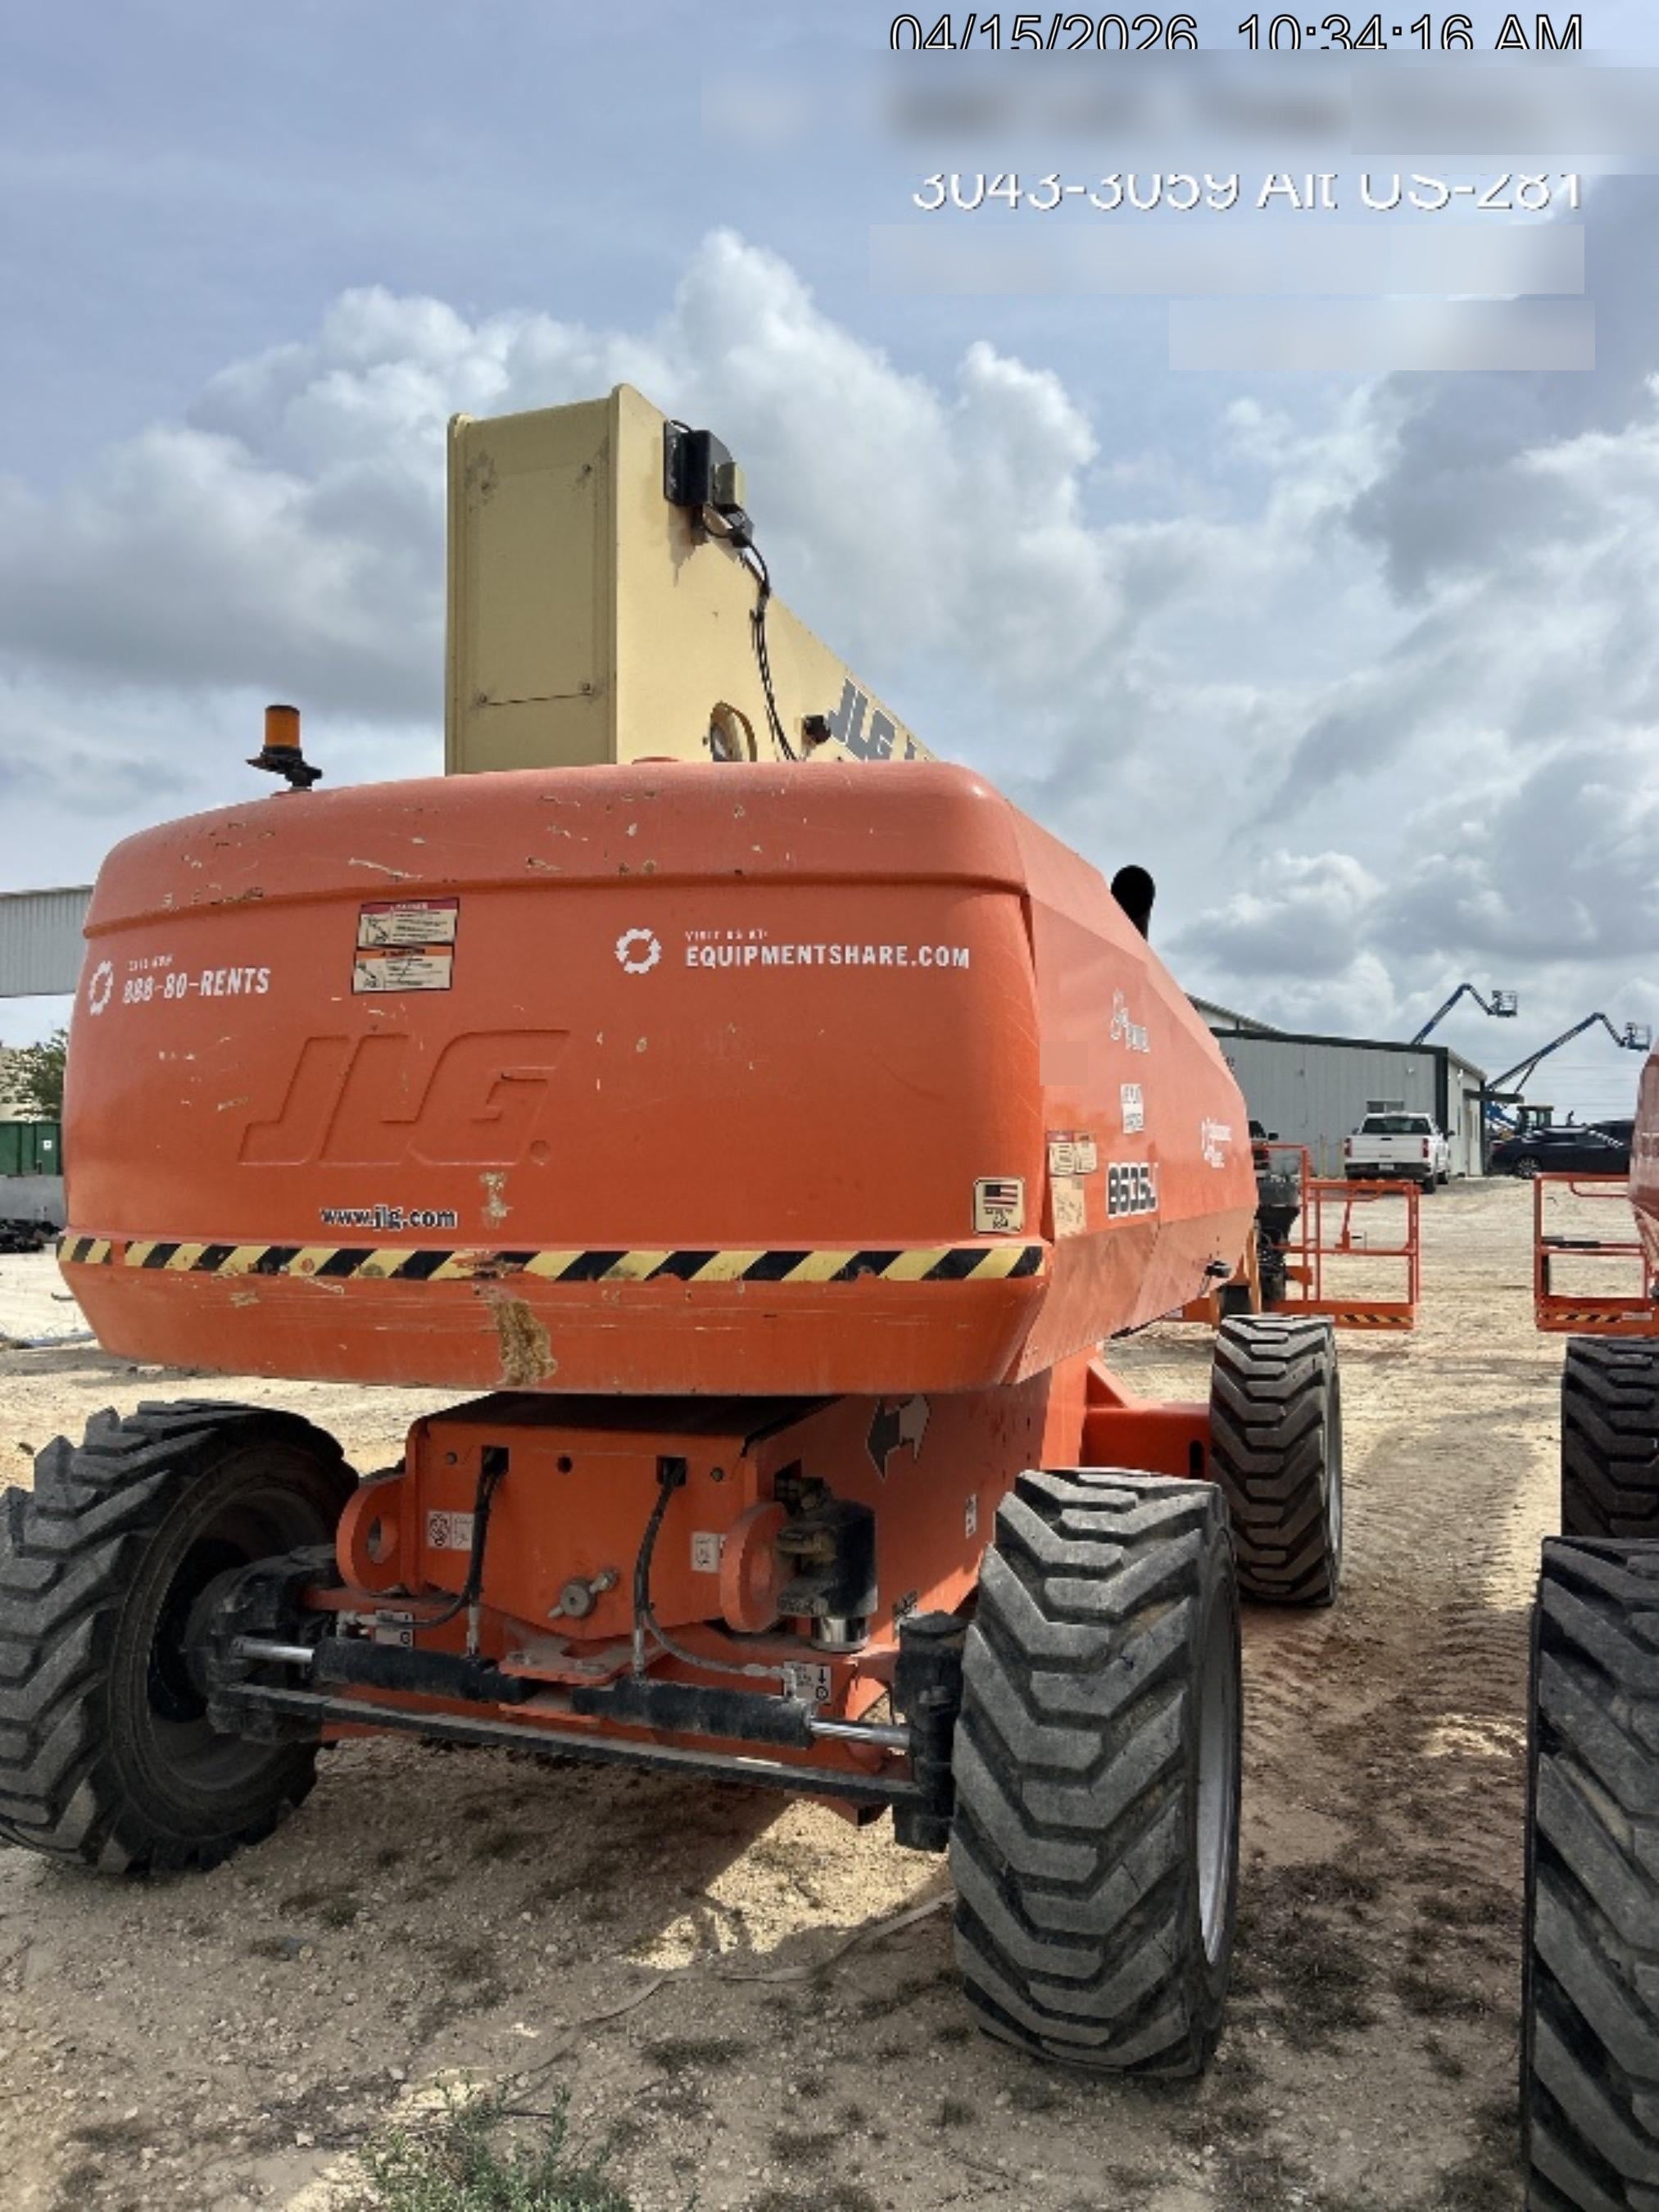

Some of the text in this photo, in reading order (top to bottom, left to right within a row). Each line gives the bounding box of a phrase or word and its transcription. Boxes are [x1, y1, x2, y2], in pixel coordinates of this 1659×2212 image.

[686, 945, 970, 969] EQUIPMENTSHARE.COM
[122, 967, 271, 1005] 888-80-RENTS
[320, 1204, 458, 1232] www.jlg.com
